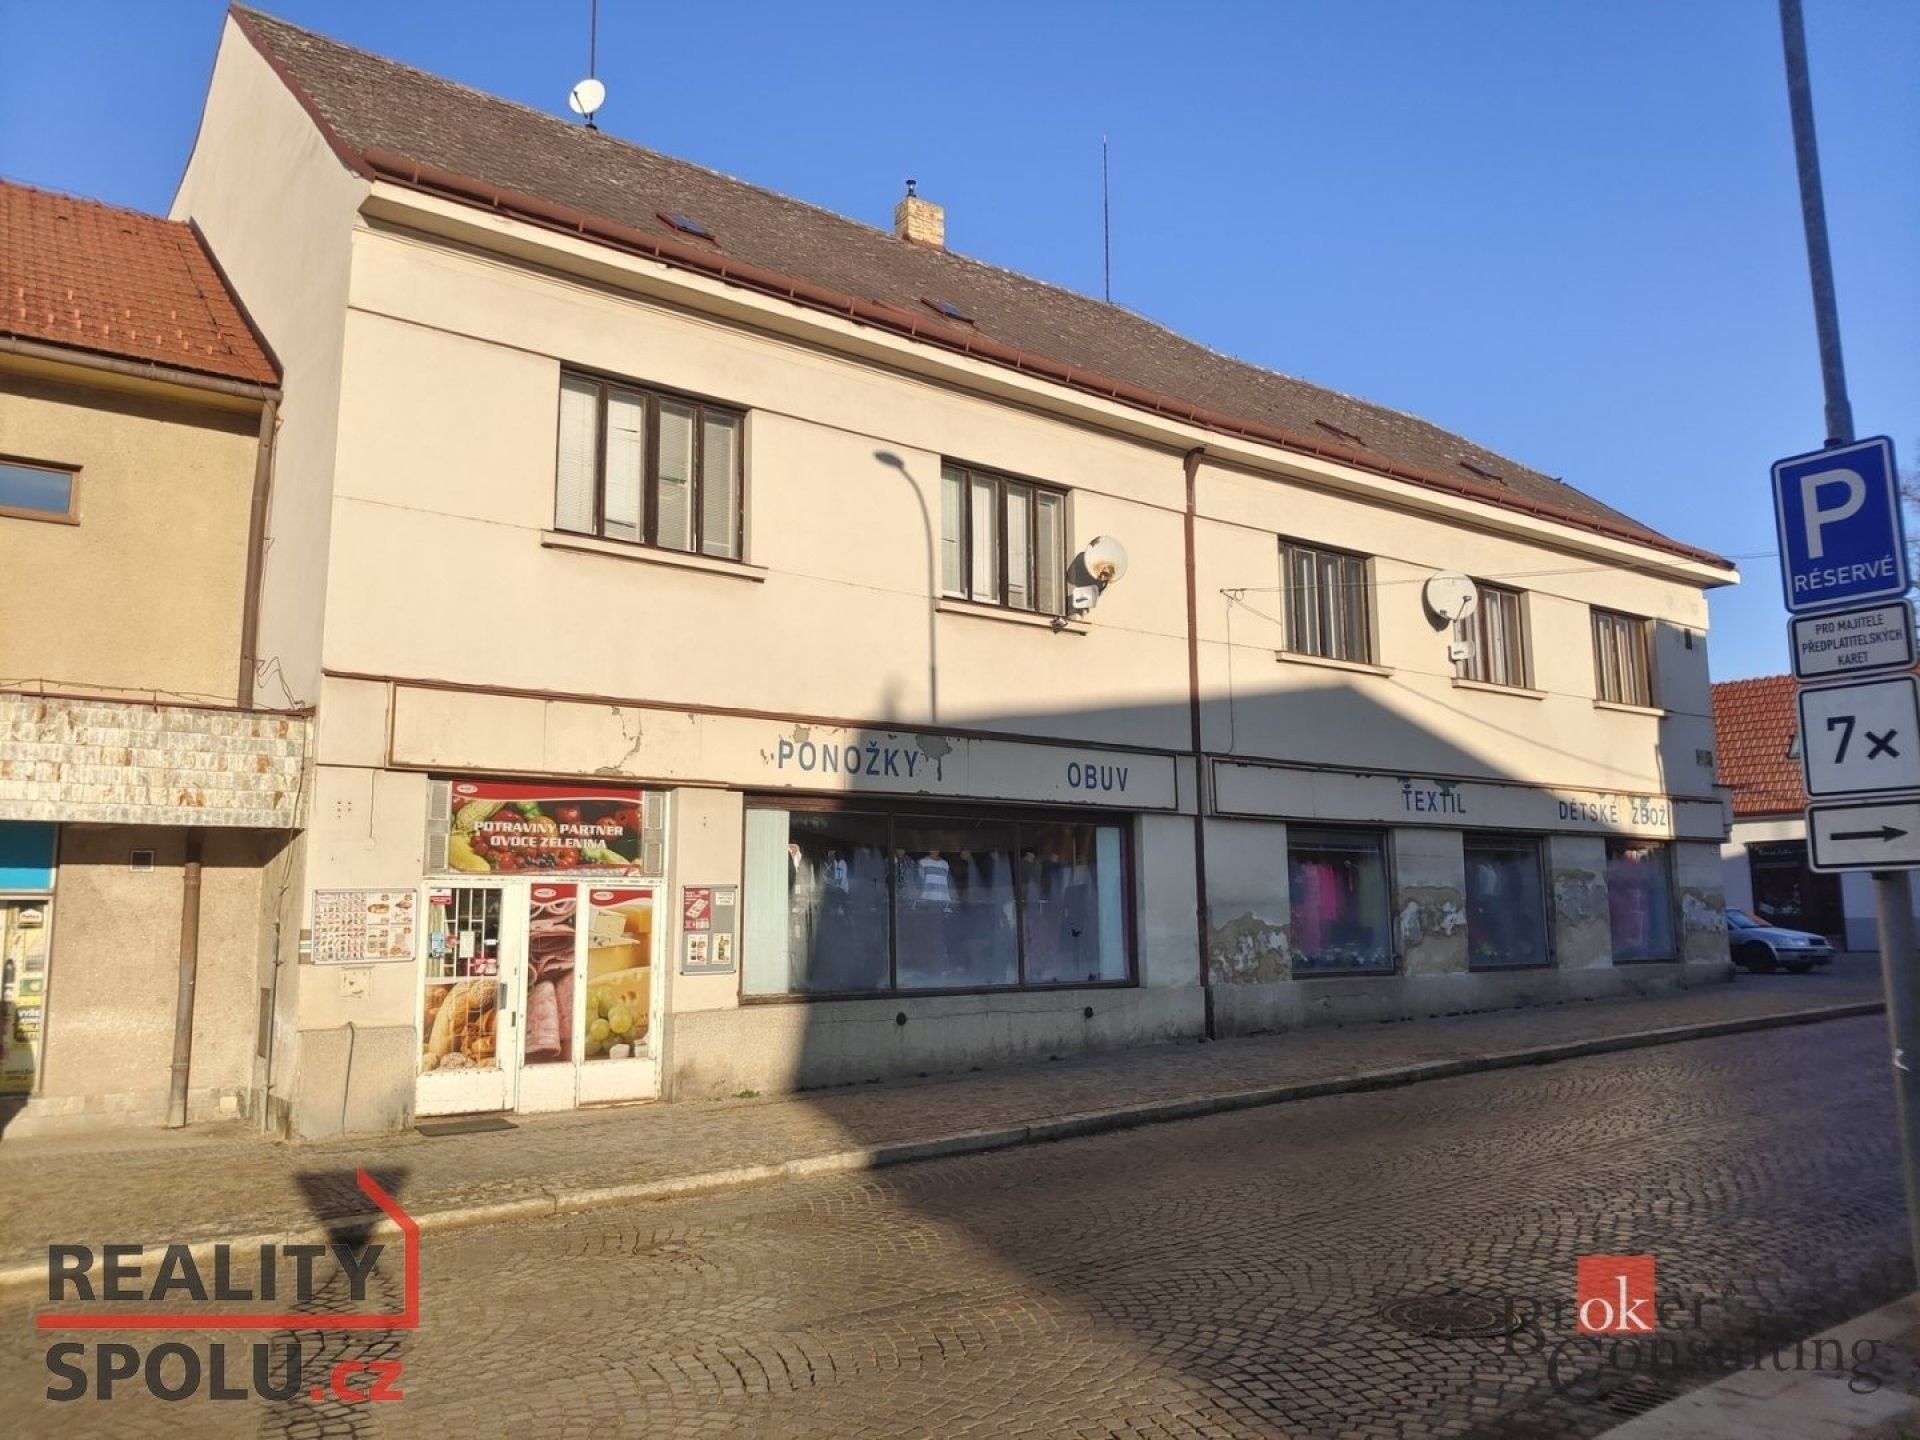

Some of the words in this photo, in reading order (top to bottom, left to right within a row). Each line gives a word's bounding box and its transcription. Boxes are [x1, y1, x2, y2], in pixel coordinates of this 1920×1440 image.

[1800, 468, 1867, 559] P
[1794, 554, 1896, 592] RÉSERVÉ
[1815, 622, 1835, 635] PRO
[1837, 651, 1868, 666] KARET
[777, 739, 919, 777] PONOŽKY
[1066, 762, 1129, 792] OBUV
[1402, 790, 1467, 814] TEXTIL
[474, 821, 557, 834] POTRAVINY
[559, 823, 624, 836] PARTNER
[490, 836, 537, 848] OVOCE
[540, 837, 607, 849] ZELENINA
